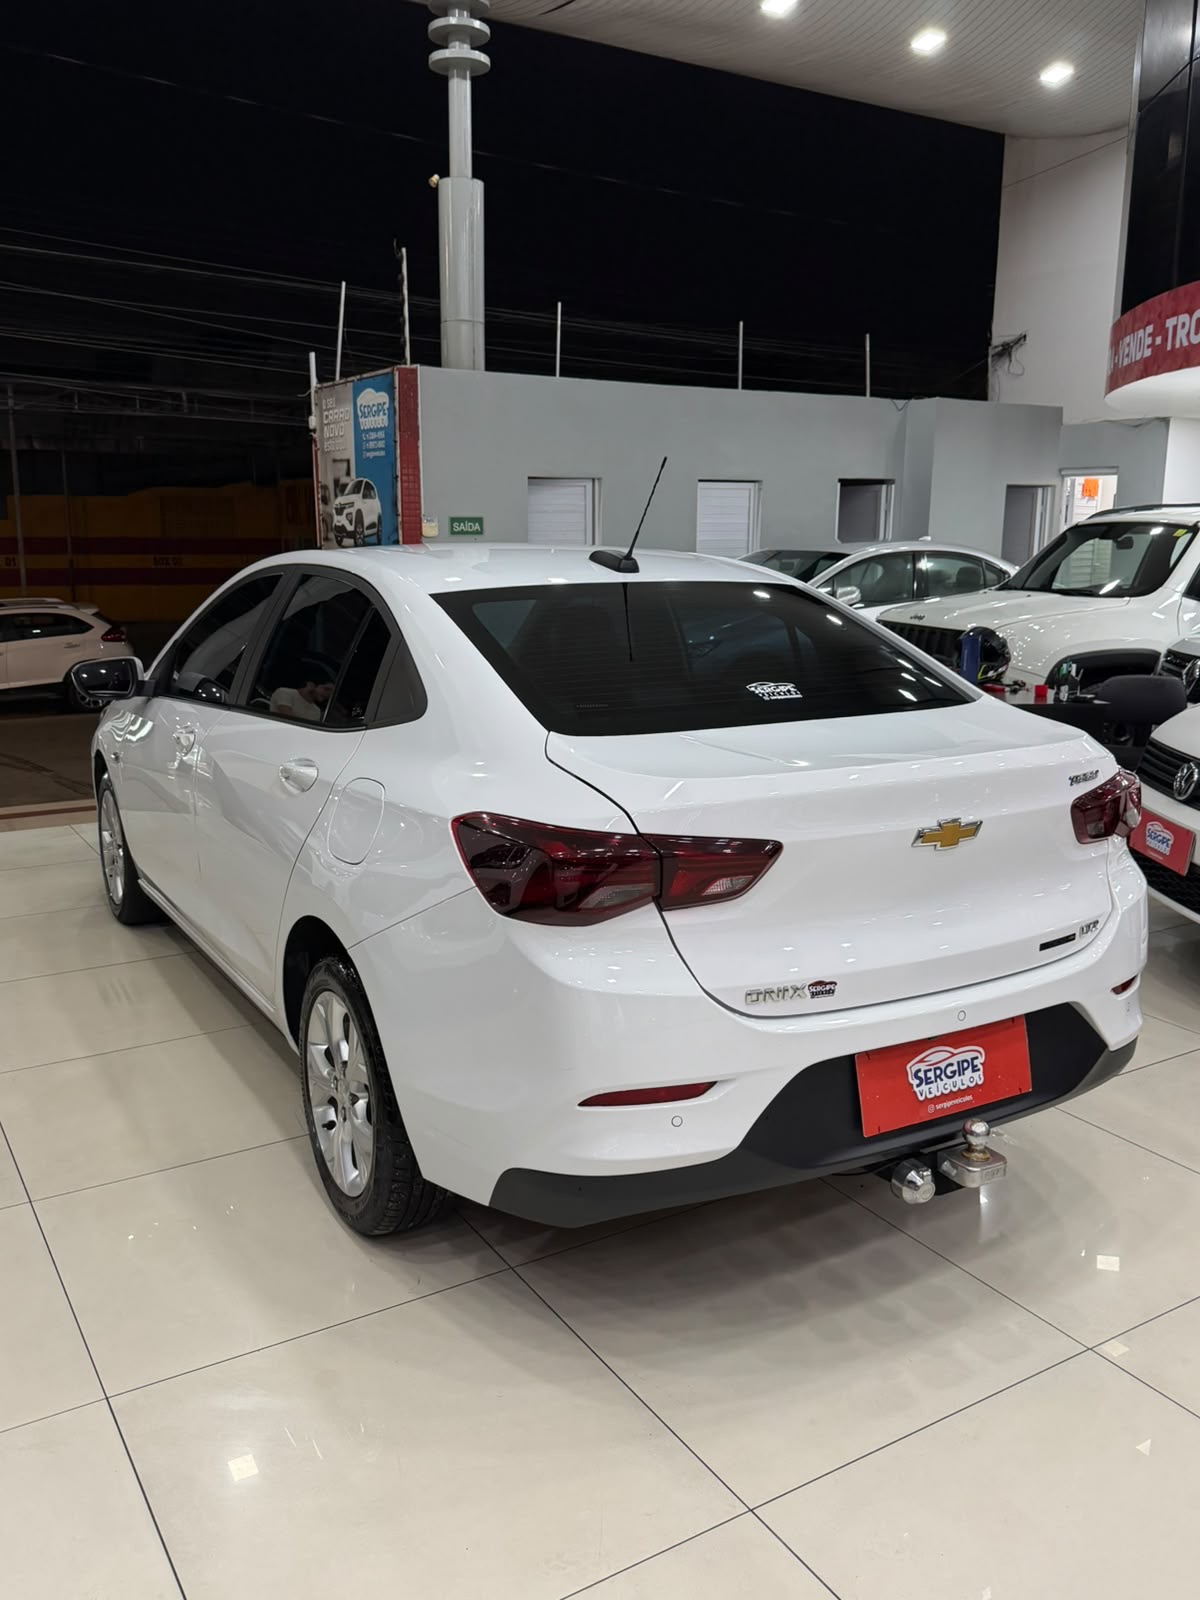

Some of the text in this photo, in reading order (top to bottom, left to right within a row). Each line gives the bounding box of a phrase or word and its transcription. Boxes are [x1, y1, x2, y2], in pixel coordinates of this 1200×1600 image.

[1119, 324, 1153, 368] VENDE
[323, 407, 350, 424] CARRO
[359, 401, 387, 419] SERGIPE
[323, 422, 345, 438] NOVO
[452, 520, 481, 532] SAÍDA
[745, 983, 807, 1005] ONIX
[913, 1055, 981, 1088] SERGIPE
[918, 1073, 982, 1098] VEÍCULOS
